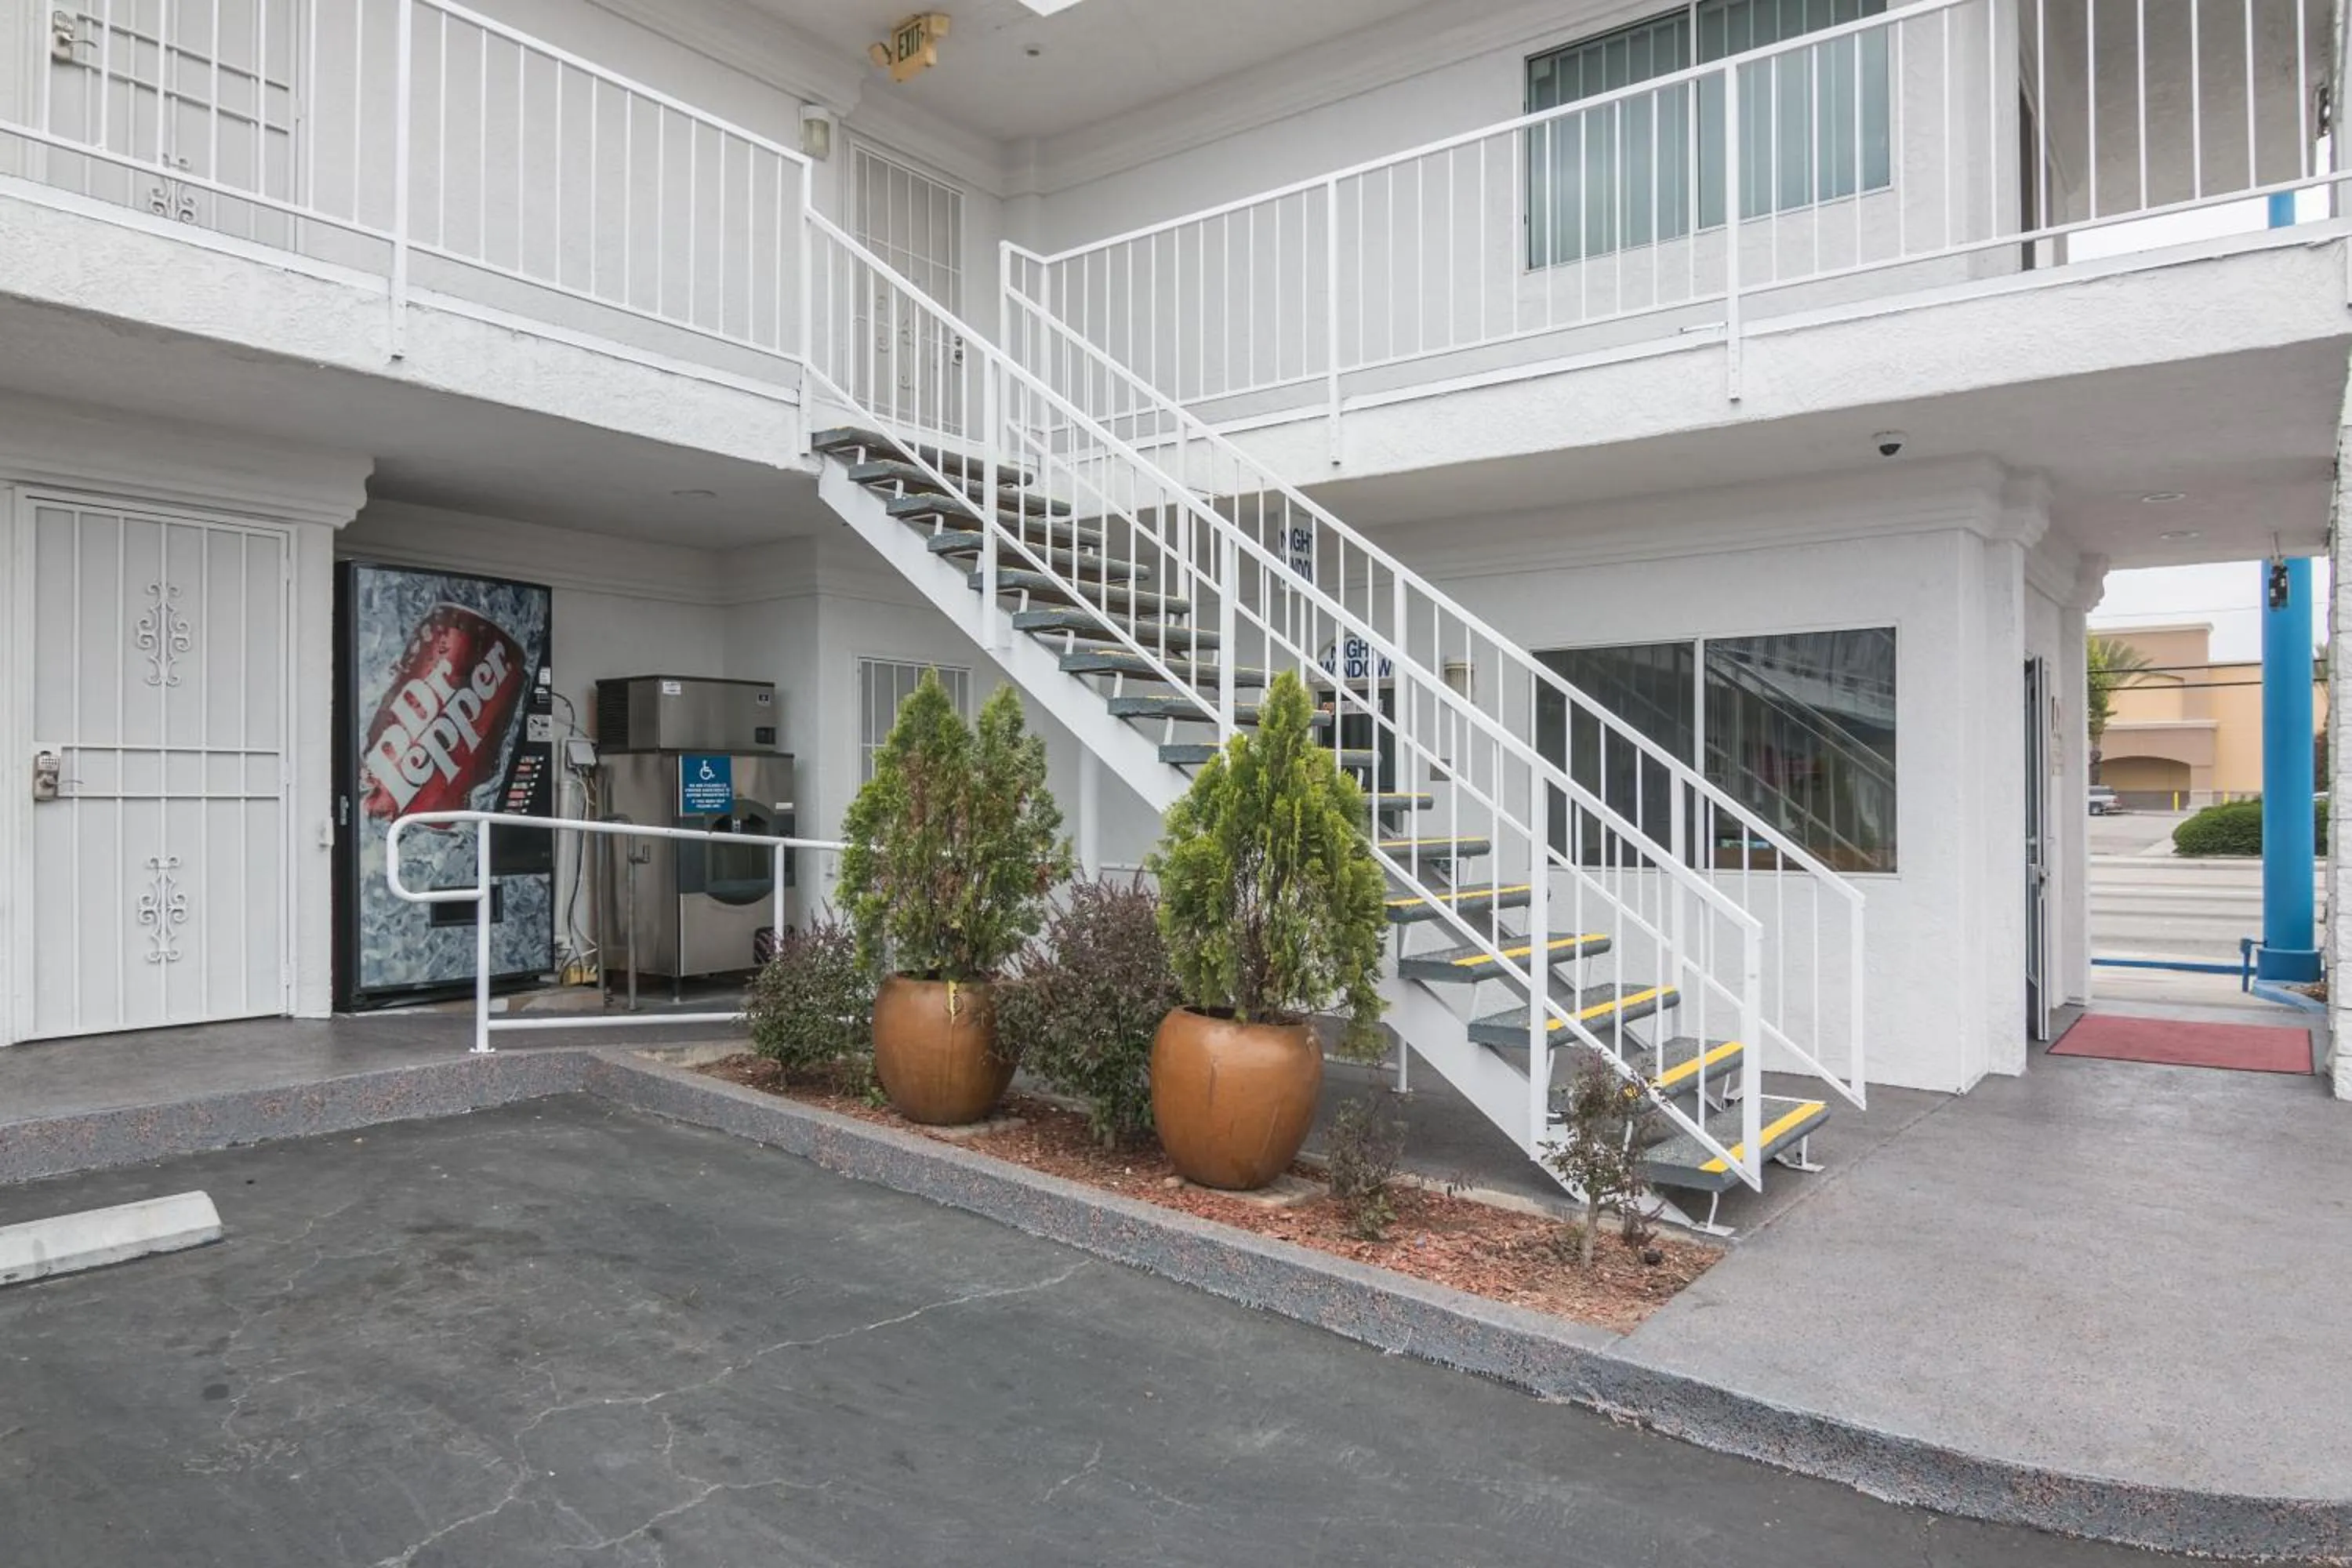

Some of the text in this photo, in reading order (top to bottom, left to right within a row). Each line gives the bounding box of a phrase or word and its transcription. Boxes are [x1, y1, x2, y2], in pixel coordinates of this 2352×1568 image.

[898, 24, 924, 63] EXIT
[365, 641, 509, 813] Pepper
[390, 657, 456, 741] Dr
